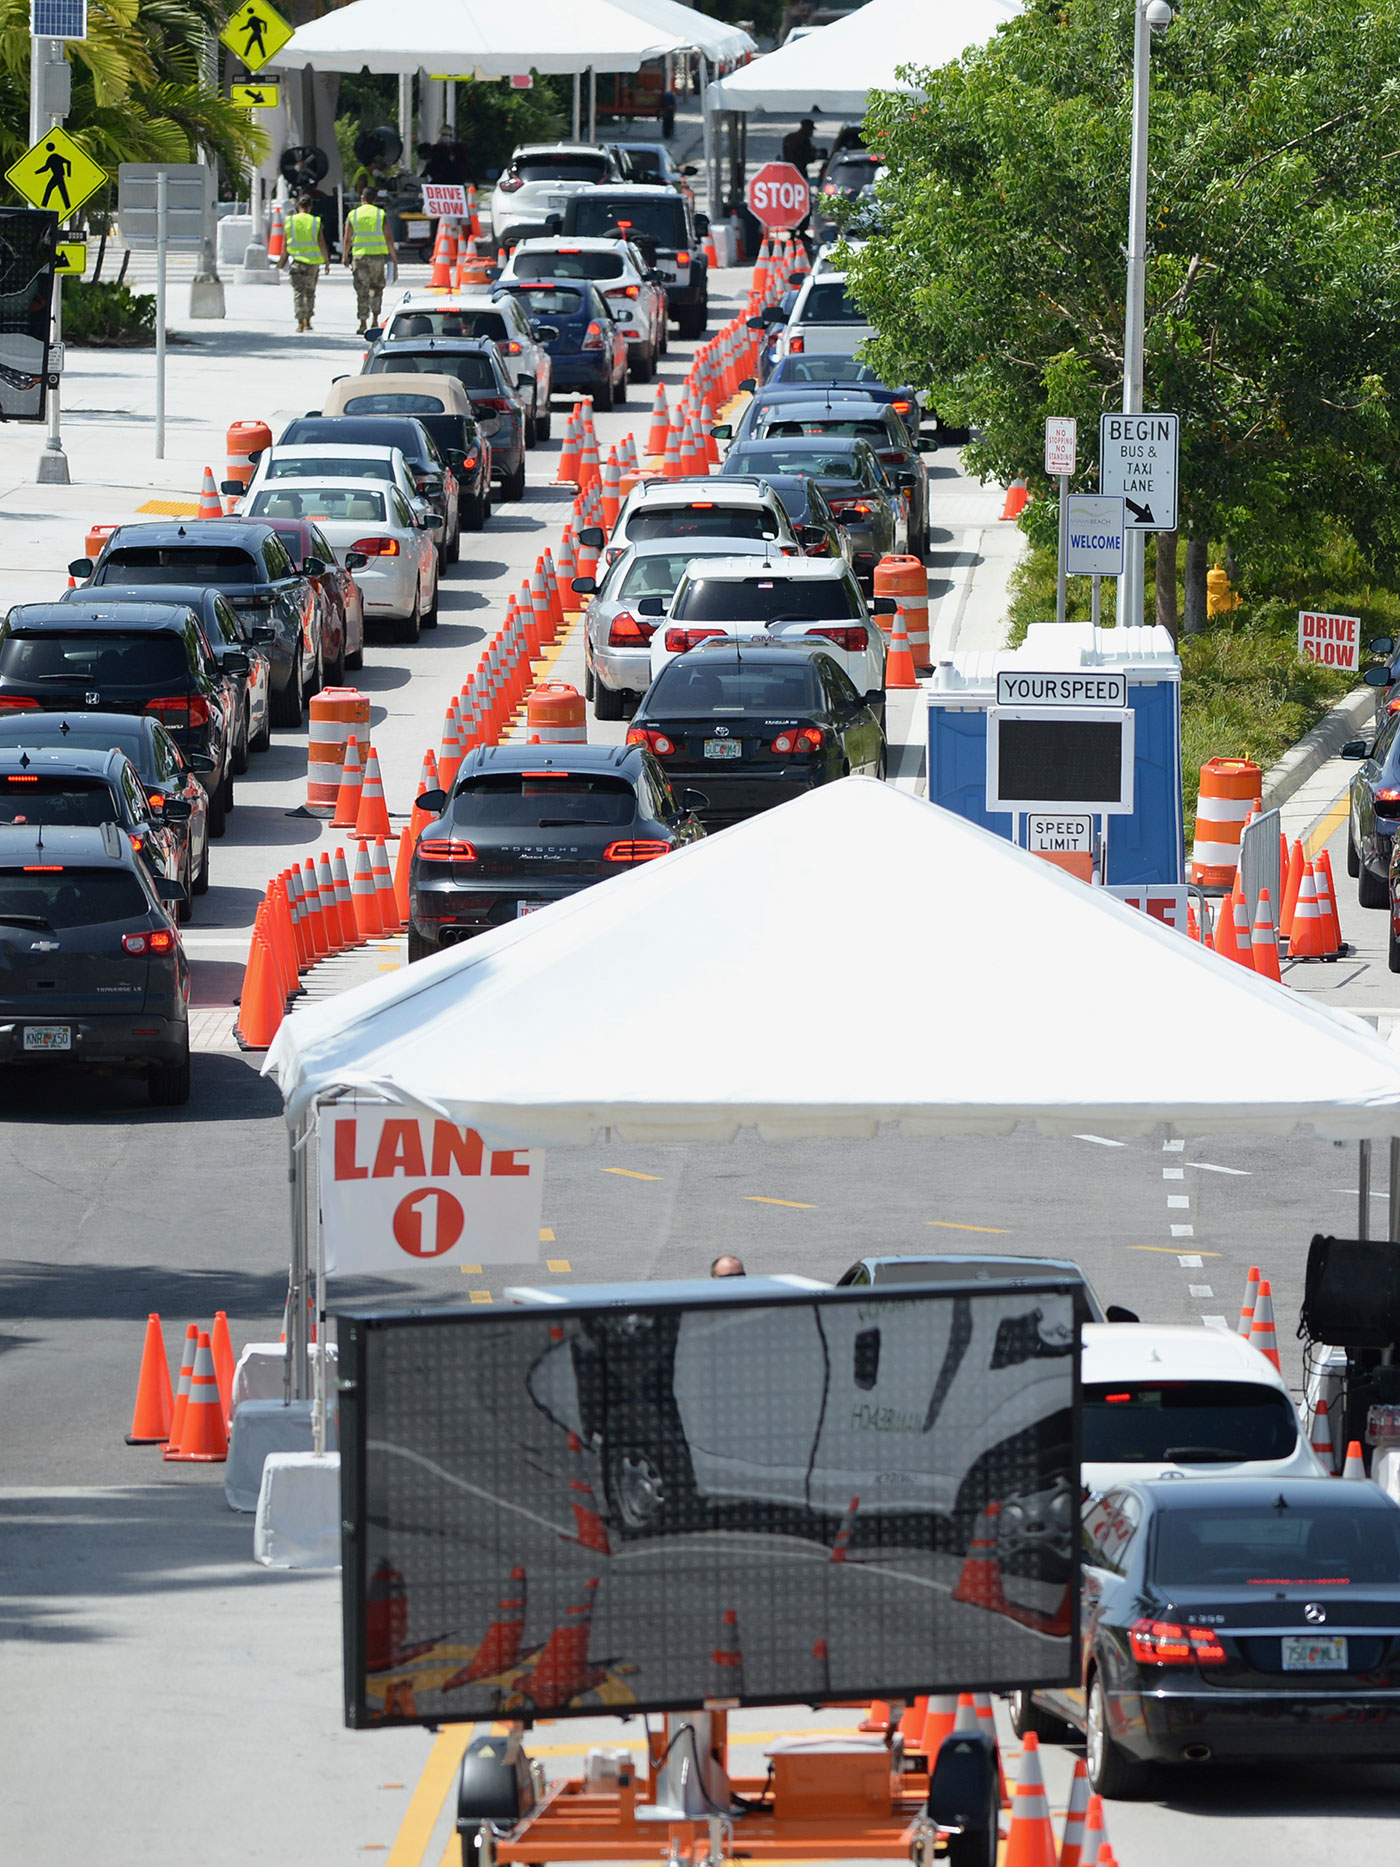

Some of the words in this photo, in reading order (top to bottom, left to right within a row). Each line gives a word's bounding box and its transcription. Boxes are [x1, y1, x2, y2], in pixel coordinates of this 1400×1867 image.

[426, 187, 462, 200] DRIVE
[754, 181, 805, 209] STOP
[429, 201, 464, 215] SLOW
[1110, 421, 1169, 441] BEGIN
[1121, 446, 1144, 457] BUS
[1148, 446, 1157, 457] &
[1127, 463, 1152, 475] TAXI
[1123, 480, 1154, 491] LANE
[1071, 535, 1121, 549] WELCOME
[1303, 615, 1356, 642] DRIVE
[1303, 640, 1354, 667] SLOW
[1036, 822, 1085, 834] SPEED
[1041, 839, 1079, 850] LIMIT
[26, 1034, 43, 1044] KNR
[411, 1193, 438, 1253] 1
